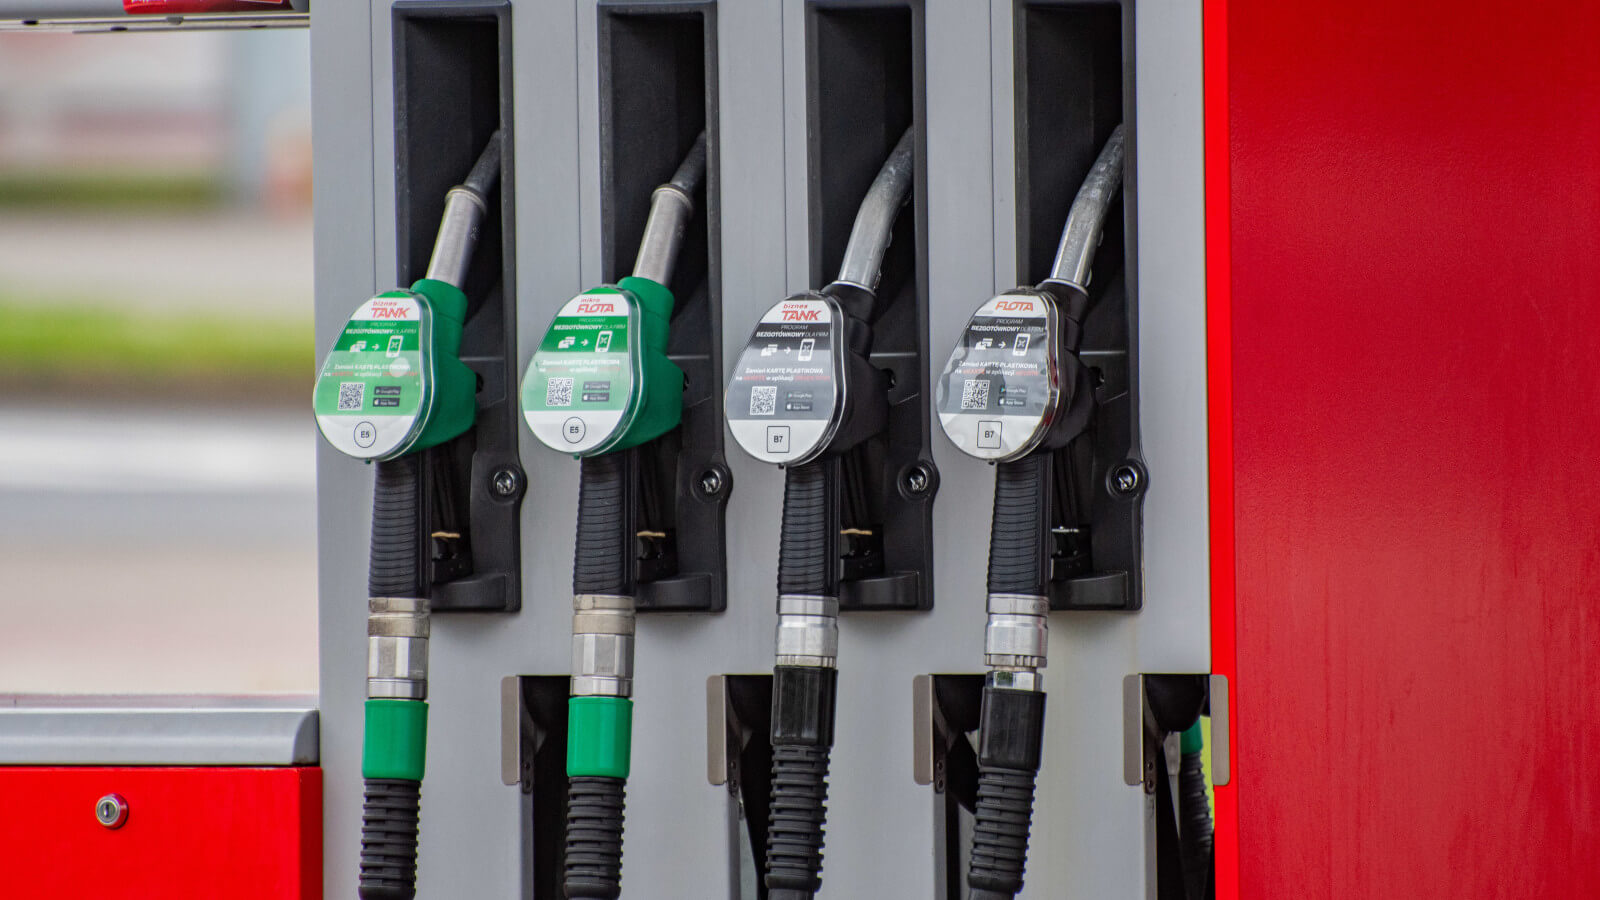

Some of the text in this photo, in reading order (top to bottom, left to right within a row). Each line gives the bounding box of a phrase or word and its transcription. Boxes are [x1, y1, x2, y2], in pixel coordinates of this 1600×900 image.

[576, 303, 615, 314] FLOTA
[994, 301, 1034, 312] FLOTA
[371, 307, 411, 319] TANK
[781, 310, 822, 321] TANK
[569, 426, 579, 434] E5
[984, 430, 995, 438] B7
[361, 431, 370, 439] E5
[773, 435, 784, 443] B7
